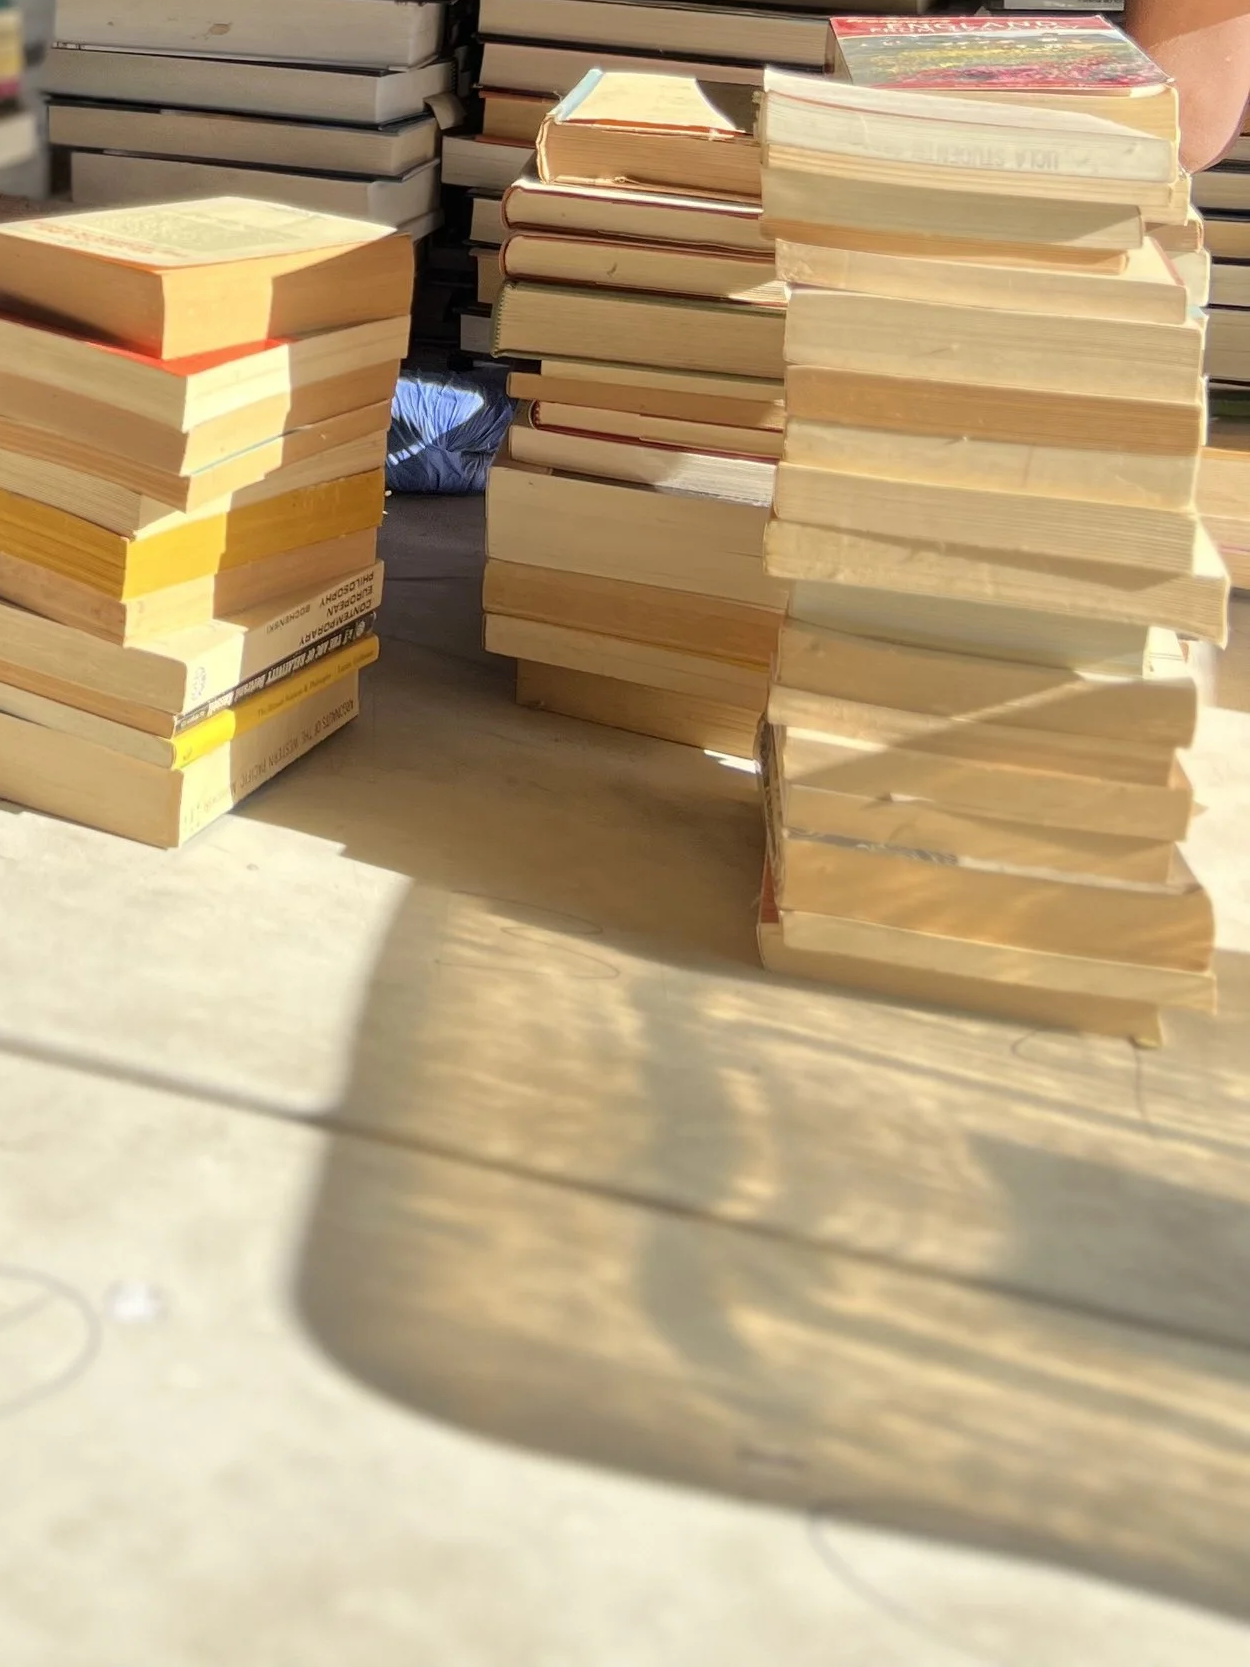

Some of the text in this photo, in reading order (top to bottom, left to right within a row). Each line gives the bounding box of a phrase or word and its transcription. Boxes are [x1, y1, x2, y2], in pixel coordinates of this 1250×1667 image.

[884, 20, 1059, 31] ENGLAND
[318, 571, 375, 609] PHILOSOPHY
[325, 585, 374, 618] EUROPEAN
[298, 599, 373, 647] CONTEMPORARY
[264, 652, 307, 685] RELATIVITY
